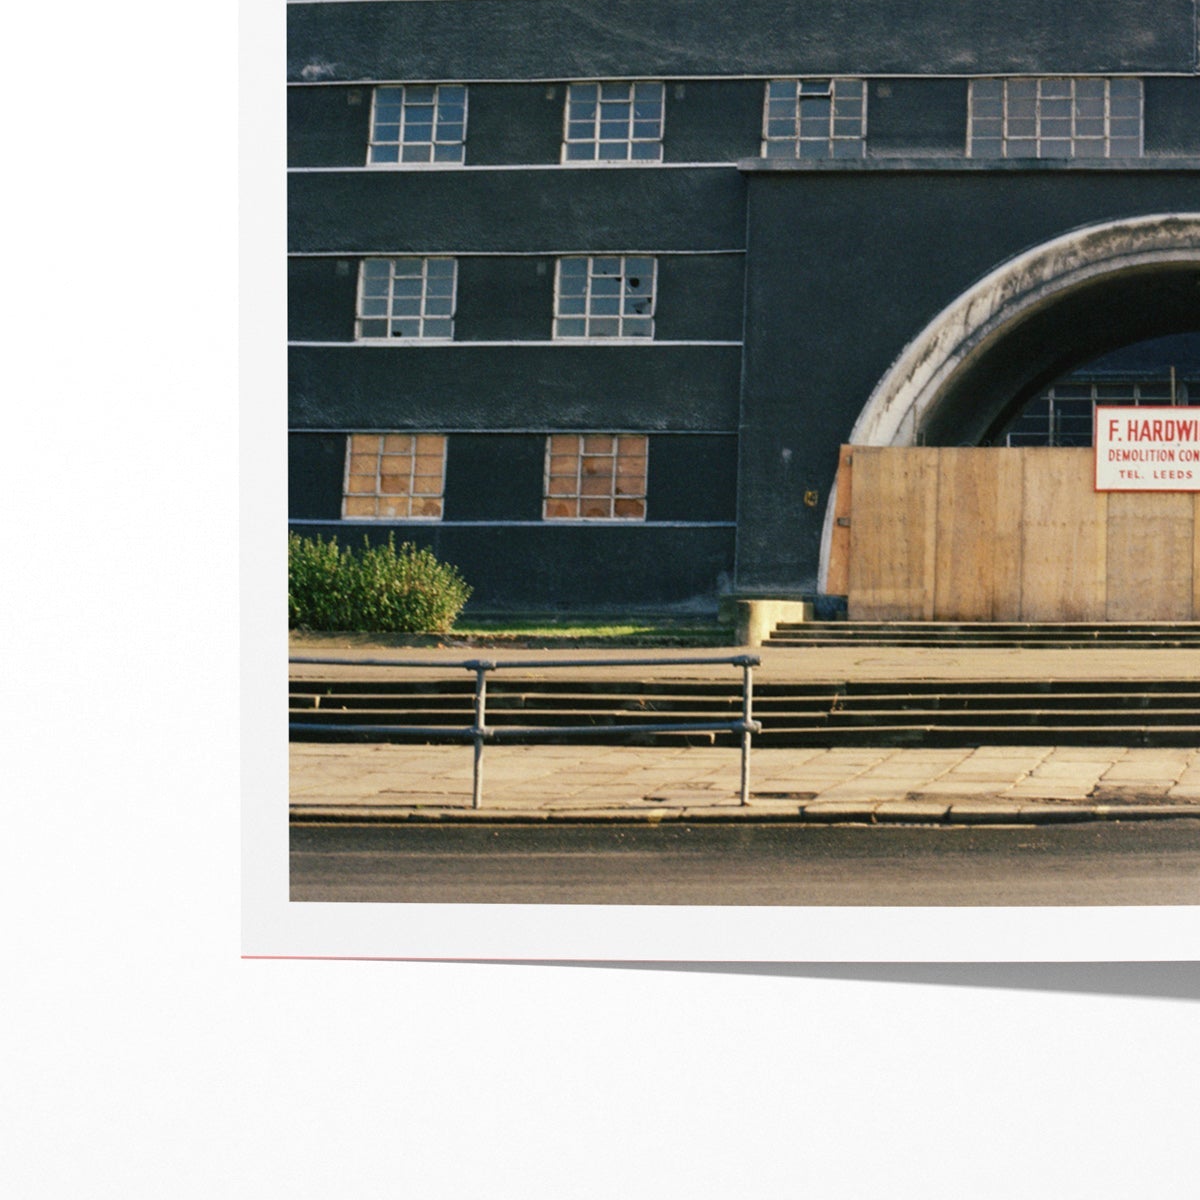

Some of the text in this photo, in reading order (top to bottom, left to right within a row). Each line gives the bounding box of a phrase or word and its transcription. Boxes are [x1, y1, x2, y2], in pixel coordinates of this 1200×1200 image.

[1109, 420, 1122, 441] F.
[1109, 449, 1175, 462] DEMOLITION
[1119, 470, 1193, 479] TEL. LEEDS
